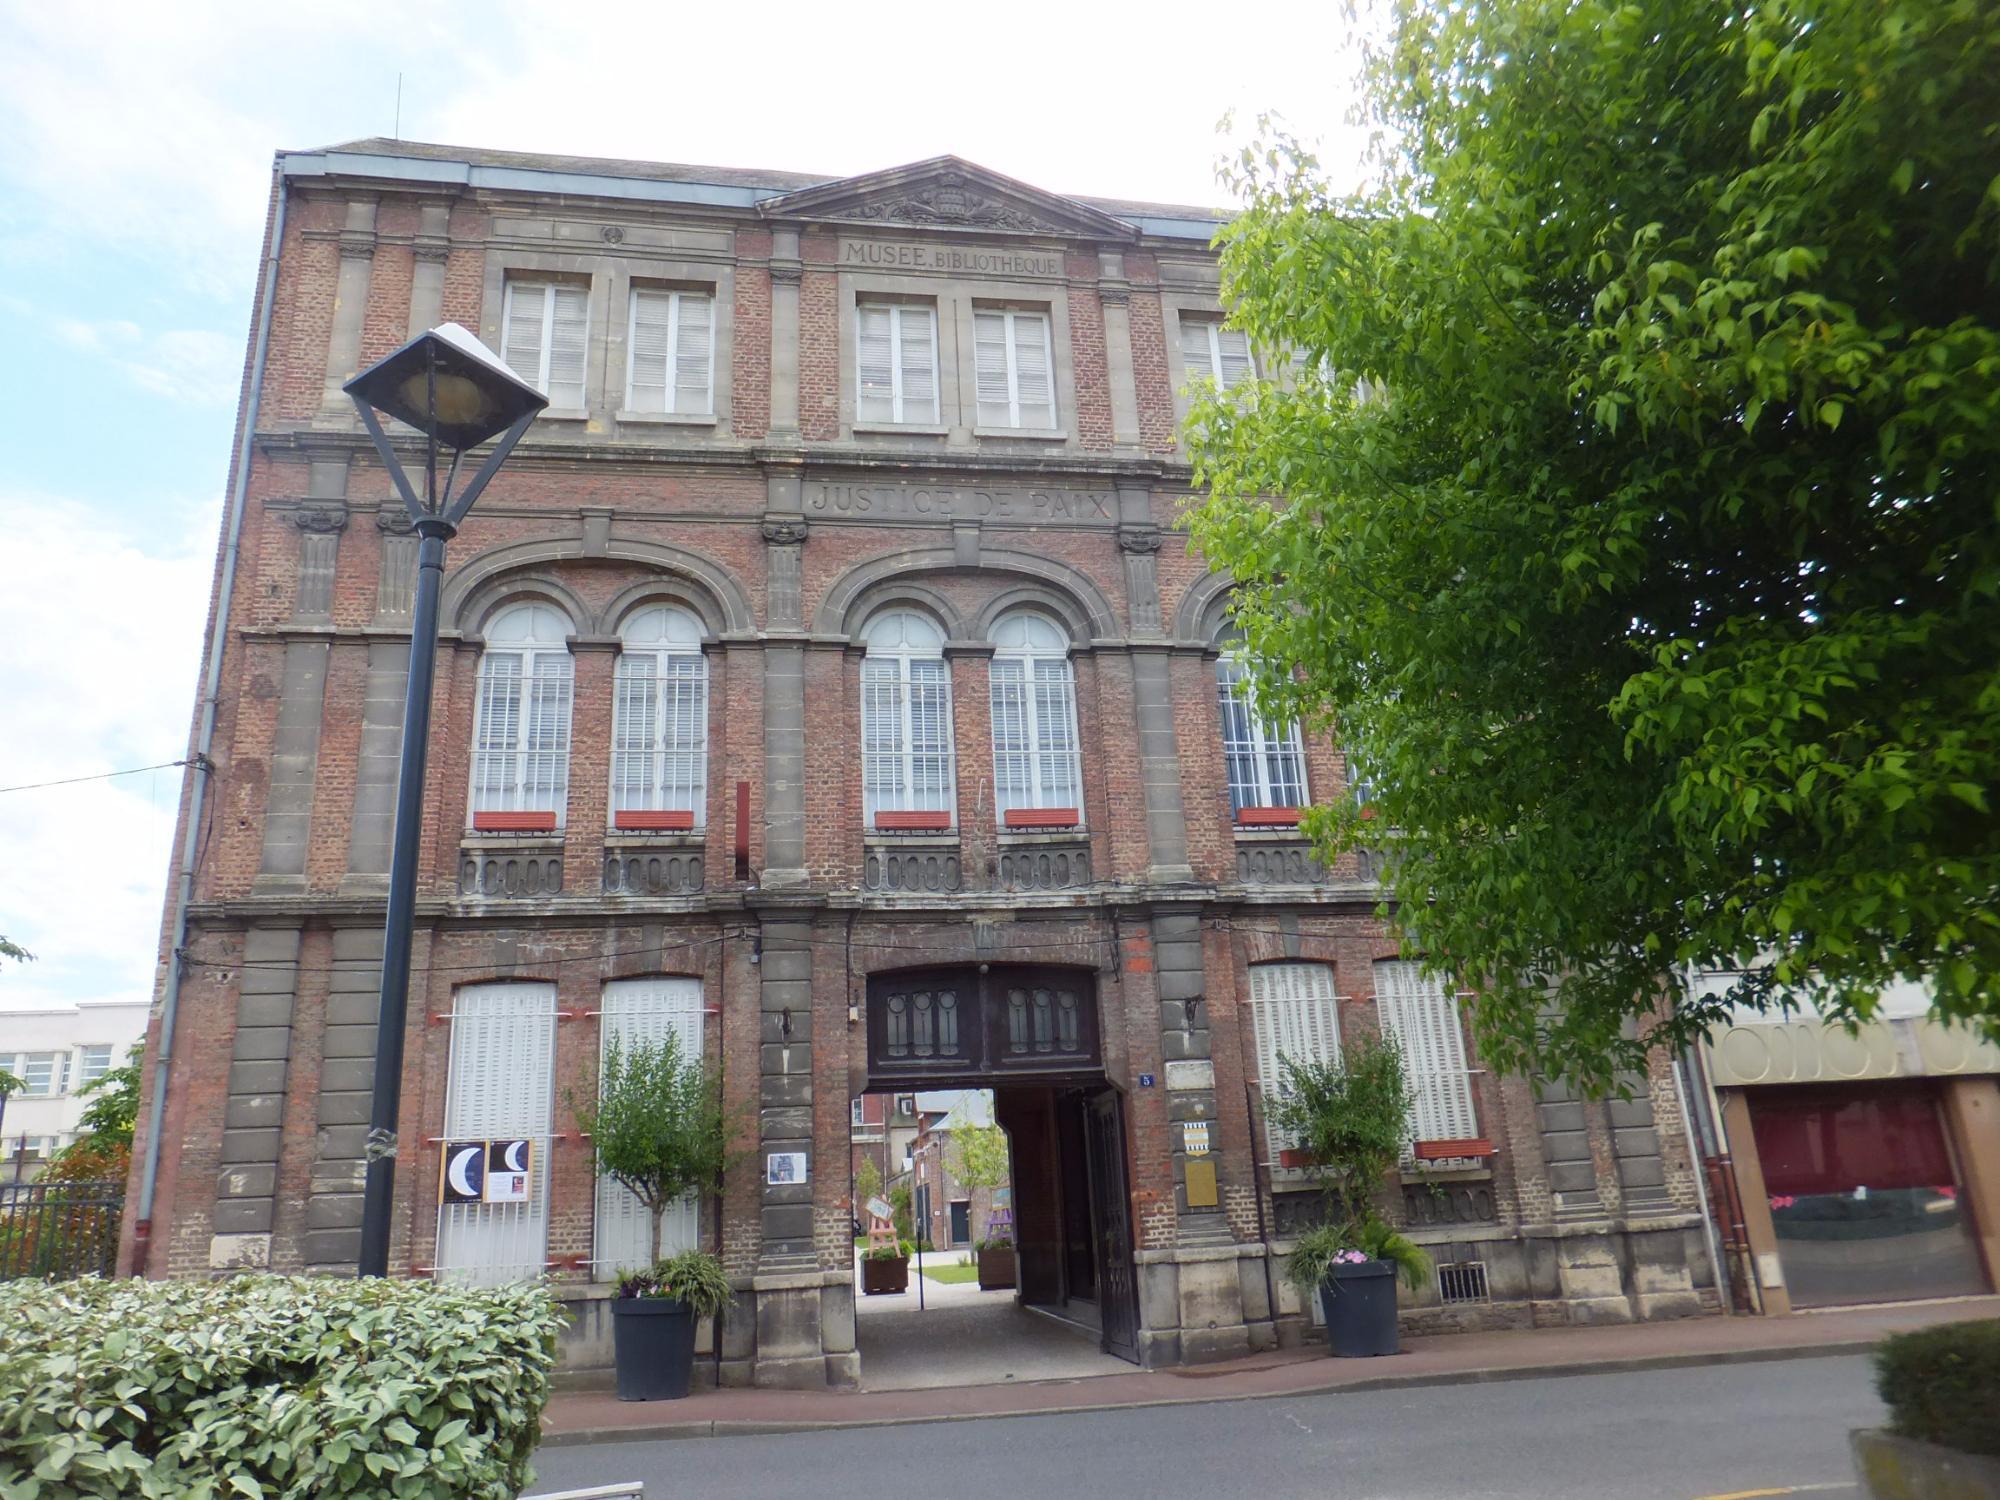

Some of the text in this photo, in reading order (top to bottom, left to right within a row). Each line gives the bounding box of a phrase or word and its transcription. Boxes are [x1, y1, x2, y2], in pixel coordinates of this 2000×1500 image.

[812, 486, 1111, 520] JUSTICE DE PAIX
